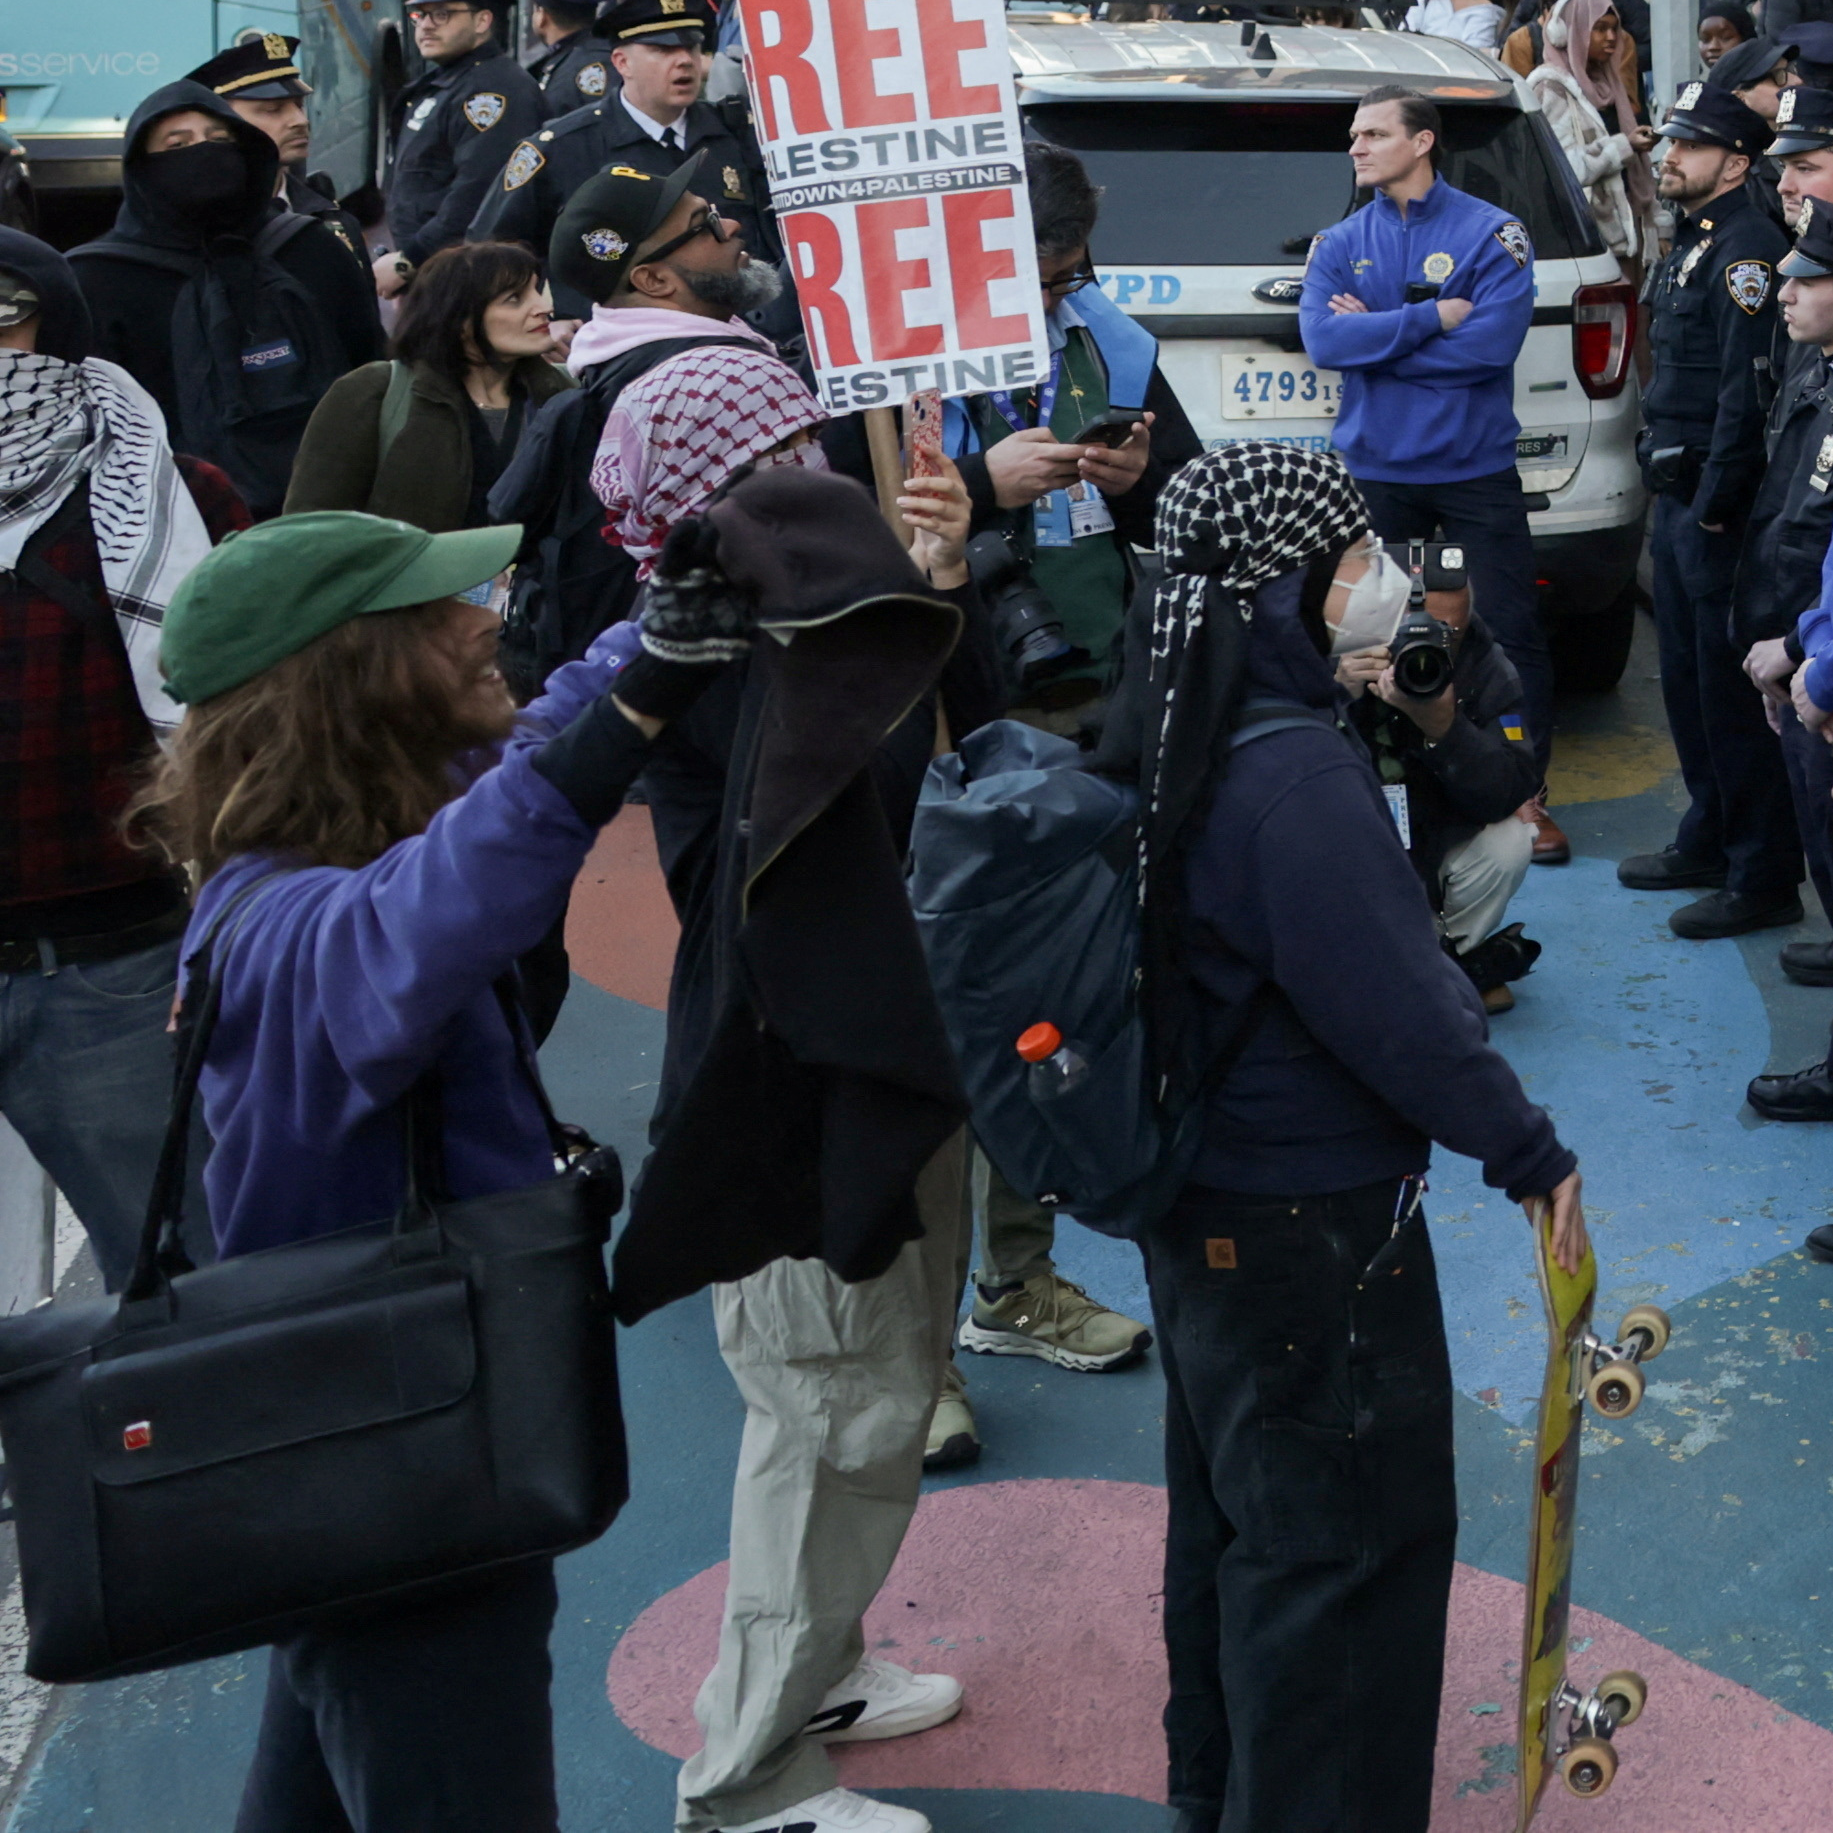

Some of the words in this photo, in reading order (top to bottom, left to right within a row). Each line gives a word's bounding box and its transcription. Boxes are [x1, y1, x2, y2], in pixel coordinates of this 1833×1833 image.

[781, 188, 1032, 371] REE
[1234, 370, 1318, 402] 4793
[1516, 441, 1541, 454] RES
